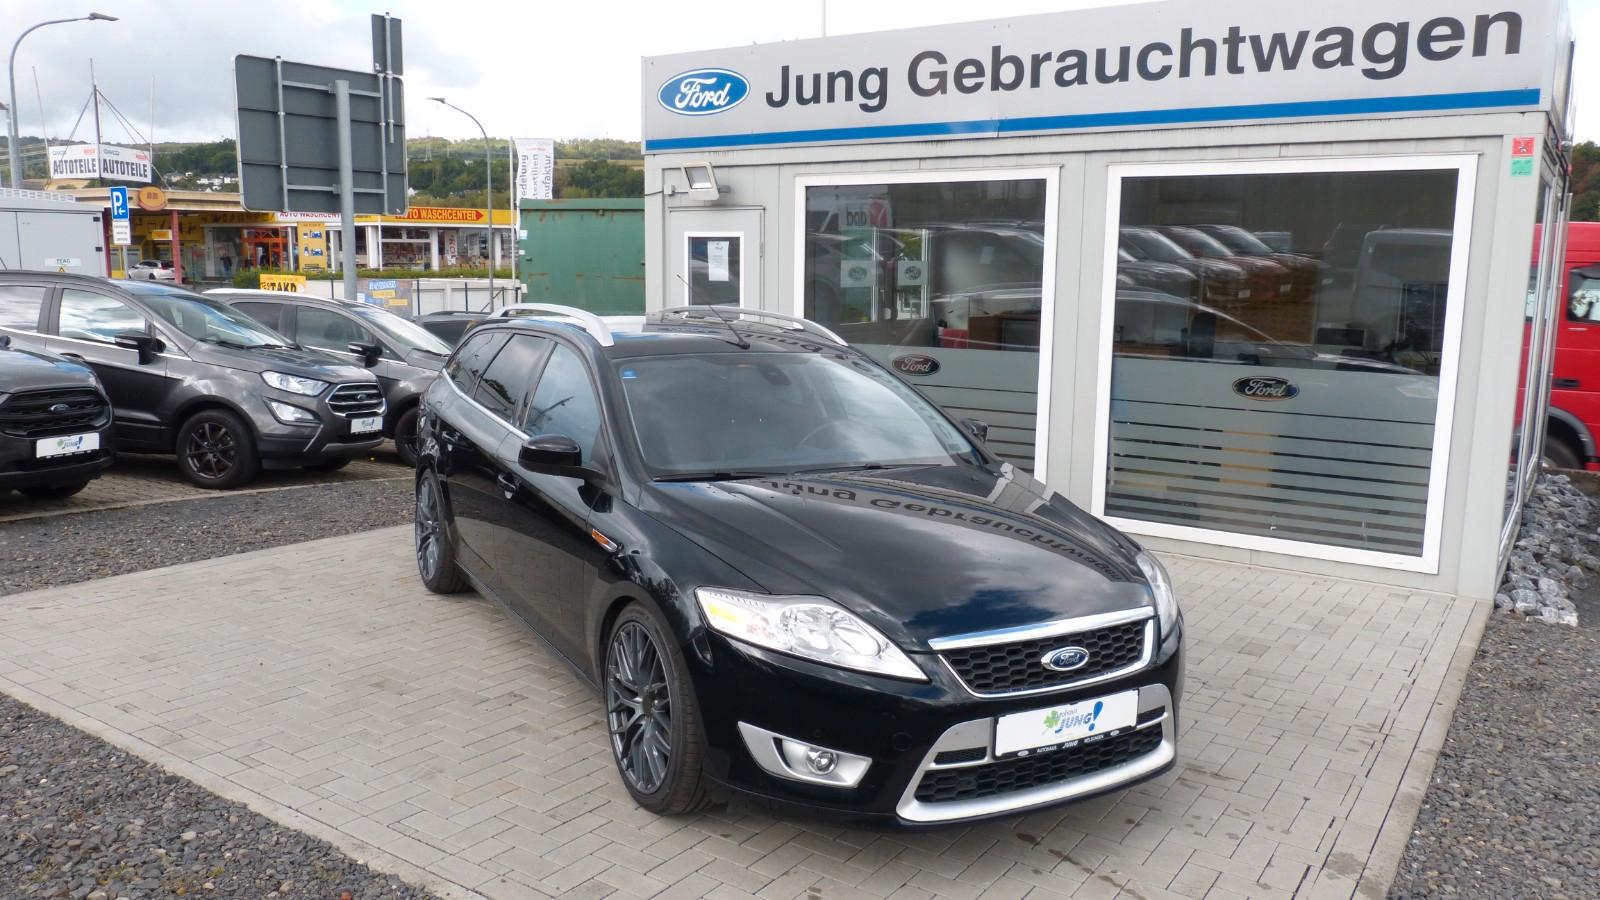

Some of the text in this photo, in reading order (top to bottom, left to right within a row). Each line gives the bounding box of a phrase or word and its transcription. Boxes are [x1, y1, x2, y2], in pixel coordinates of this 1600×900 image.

[765, 9, 1524, 113] Jung Gebrauchtwagen
[674, 77, 731, 110] Ford
[53, 158, 97, 175] AUTOTEILE
[102, 159, 148, 178] AUTOTEILE
[530, 153, 539, 199] textilien
[112, 191, 123, 215] P
[420, 208, 477, 220] WASCHCENTER
[900, 355, 931, 373] Ford
[1244, 377, 1287, 397] Ford
[1059, 652, 1080, 666] Ford
